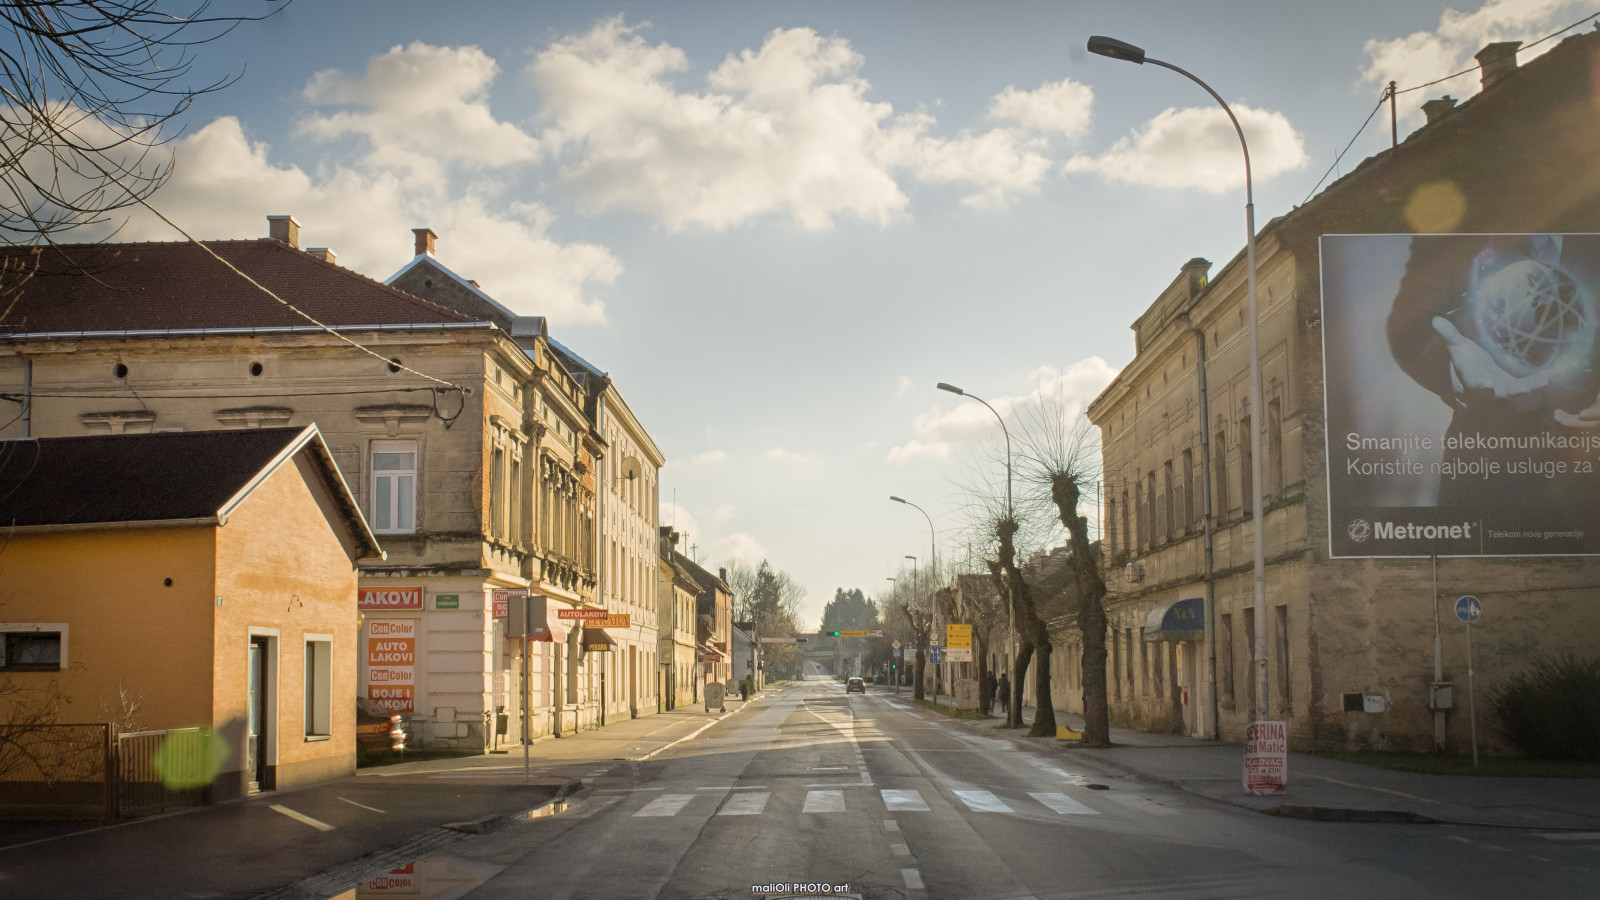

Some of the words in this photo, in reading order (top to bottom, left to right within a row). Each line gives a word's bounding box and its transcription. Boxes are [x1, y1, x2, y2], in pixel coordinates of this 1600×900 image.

[1346, 433, 1432, 454] Smanjite
[1347, 458, 1424, 475] Koristite
[1430, 457, 1500, 479] najbolje
[1507, 457, 1567, 478] usluge
[1573, 460, 1593, 473] za
[1374, 521, 1471, 539] Metronet
[1488, 530, 1521, 538] Telekom
[1543, 530, 1584, 540] generacije
[375, 642, 408, 651] AUTO
[370, 652, 413, 662] LAKOVI
[372, 688, 403, 698] BOJE
[406, 688, 411, 698] I
[370, 699, 413, 709] AKOVI
